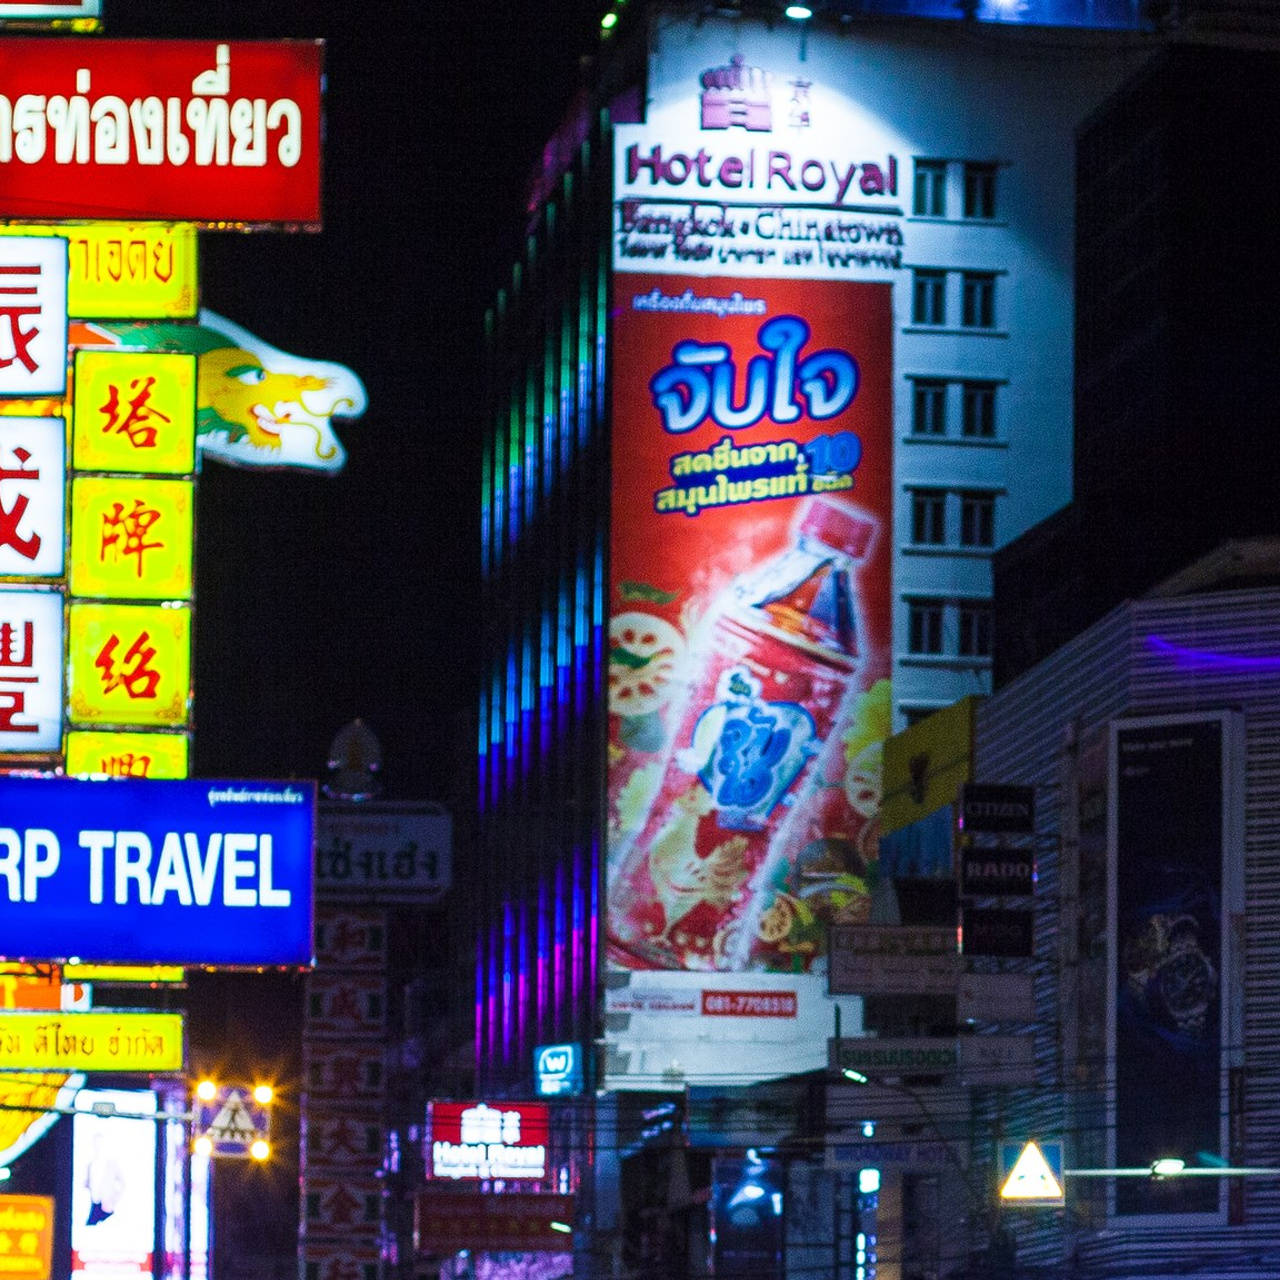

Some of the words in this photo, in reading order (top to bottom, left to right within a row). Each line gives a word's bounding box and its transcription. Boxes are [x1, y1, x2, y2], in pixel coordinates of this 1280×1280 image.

[626, 143, 754, 189] Hotel
[767, 149, 898, 206] Royal
[649, 315, 861, 434] จับใจ
[78, 830, 292, 908] TRAVEL
